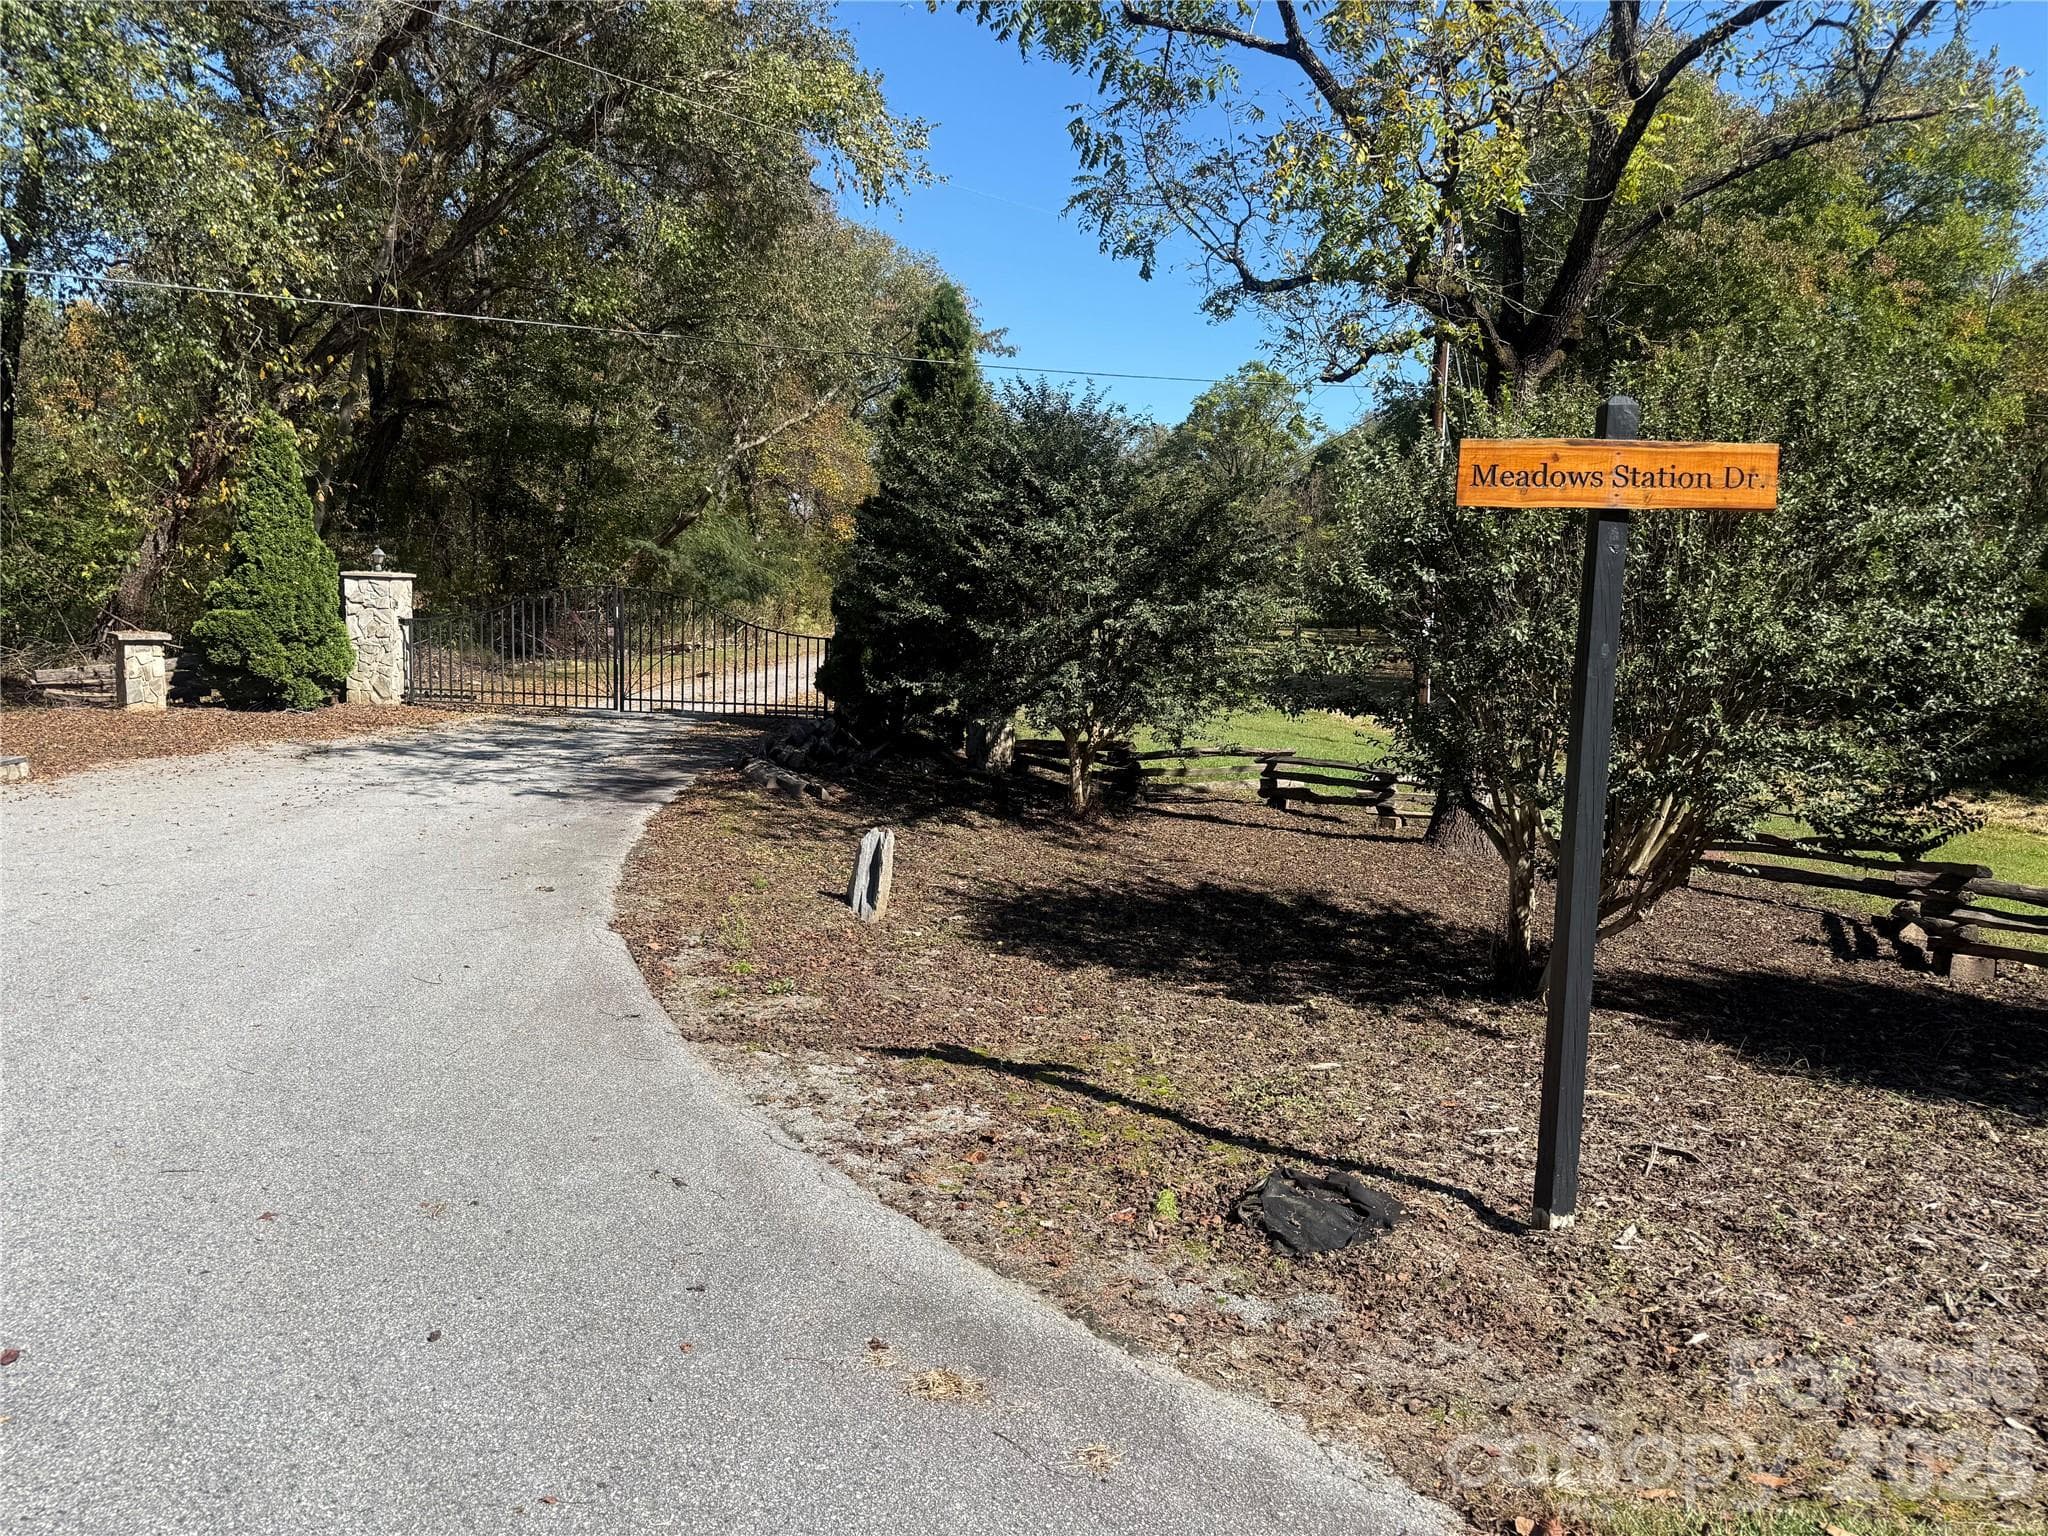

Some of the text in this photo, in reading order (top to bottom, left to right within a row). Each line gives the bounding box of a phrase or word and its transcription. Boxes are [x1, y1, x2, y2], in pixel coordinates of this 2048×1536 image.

[1470, 462, 1766, 490] Meadows Station Dr.
